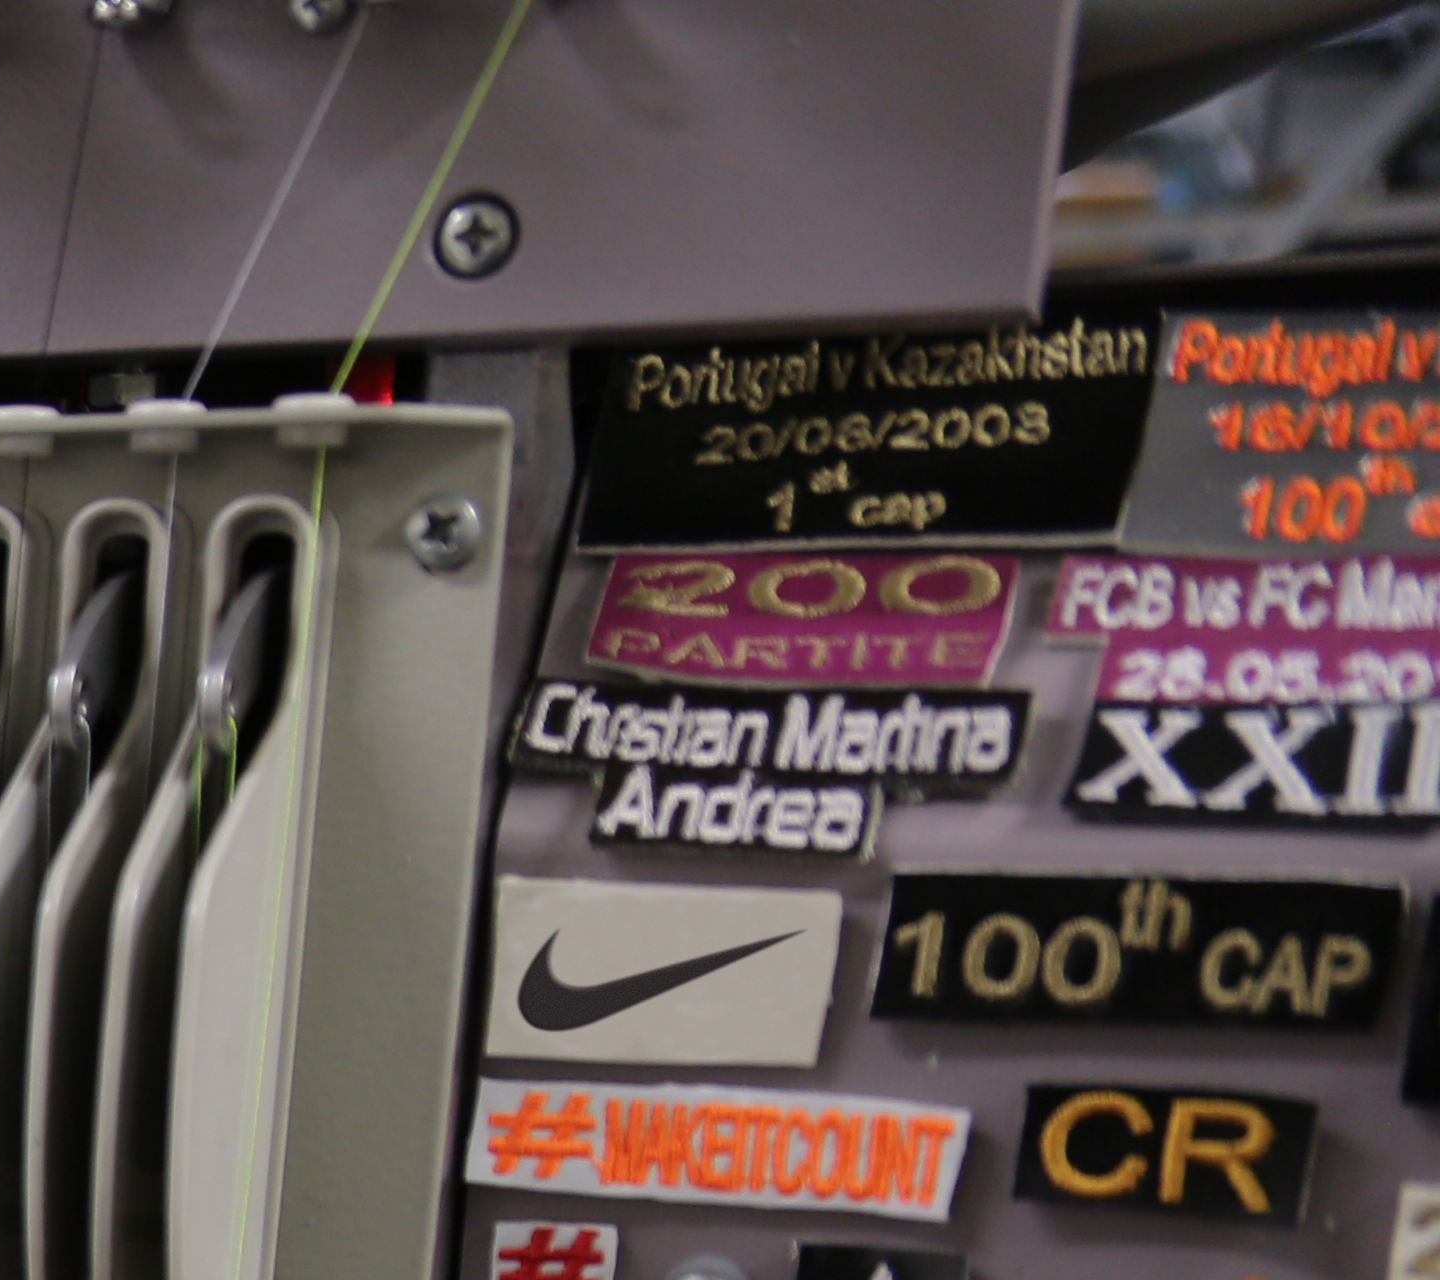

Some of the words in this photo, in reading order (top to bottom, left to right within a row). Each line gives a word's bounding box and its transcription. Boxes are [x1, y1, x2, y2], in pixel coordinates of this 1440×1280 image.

[627, 340, 820, 414] Portugal
[831, 351, 855, 392] v
[864, 316, 1147, 389] Kazakhstan
[1169, 317, 1396, 398] Portugal
[617, 555, 1002, 619] 200
[1060, 564, 1175, 629] FCB
[1183, 574, 1243, 630] vs
[1247, 561, 1334, 631] FC
[603, 627, 991, 671] PARTITE
[775, 693, 1013, 776] Martina
[596, 763, 865, 851] Andrea
[894, 878, 1192, 1004] 100th
[1200, 927, 1372, 1017] CAP
[1040, 1090, 1275, 1214] CR
